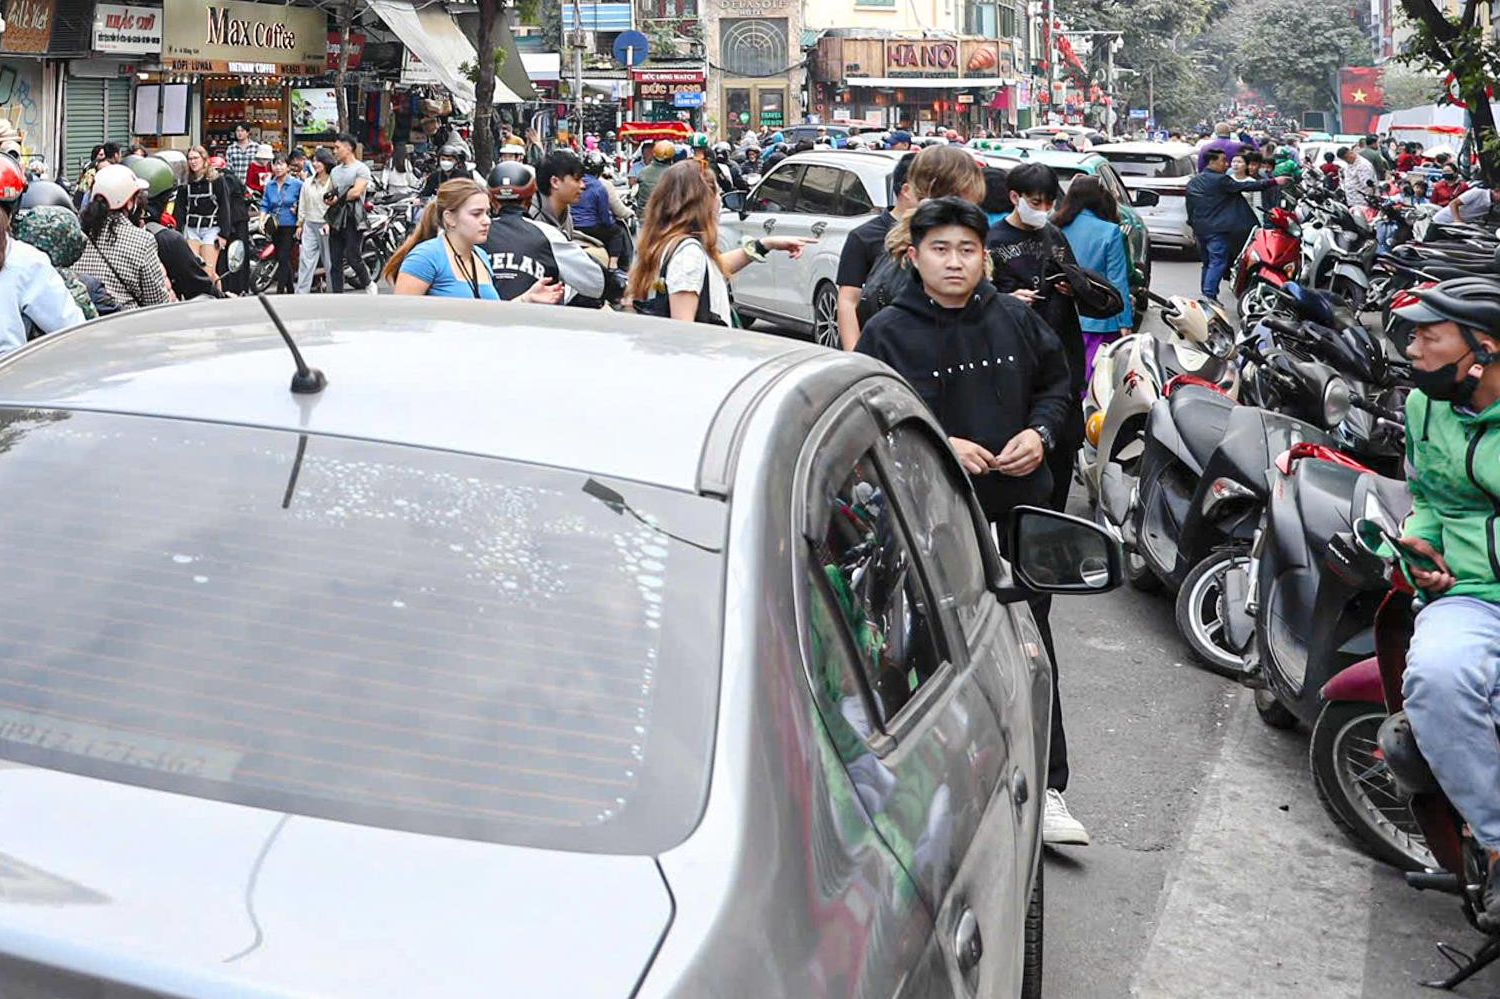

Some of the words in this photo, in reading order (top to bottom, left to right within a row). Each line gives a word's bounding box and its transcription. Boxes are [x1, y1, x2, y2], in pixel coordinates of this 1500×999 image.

[206, 6, 251, 46] Max
[253, 21, 297, 50] Coffee
[172, 60, 188, 70] KOPI
[227, 62, 255, 73] VIETNAM
[255, 63, 276, 74] COFFEE
